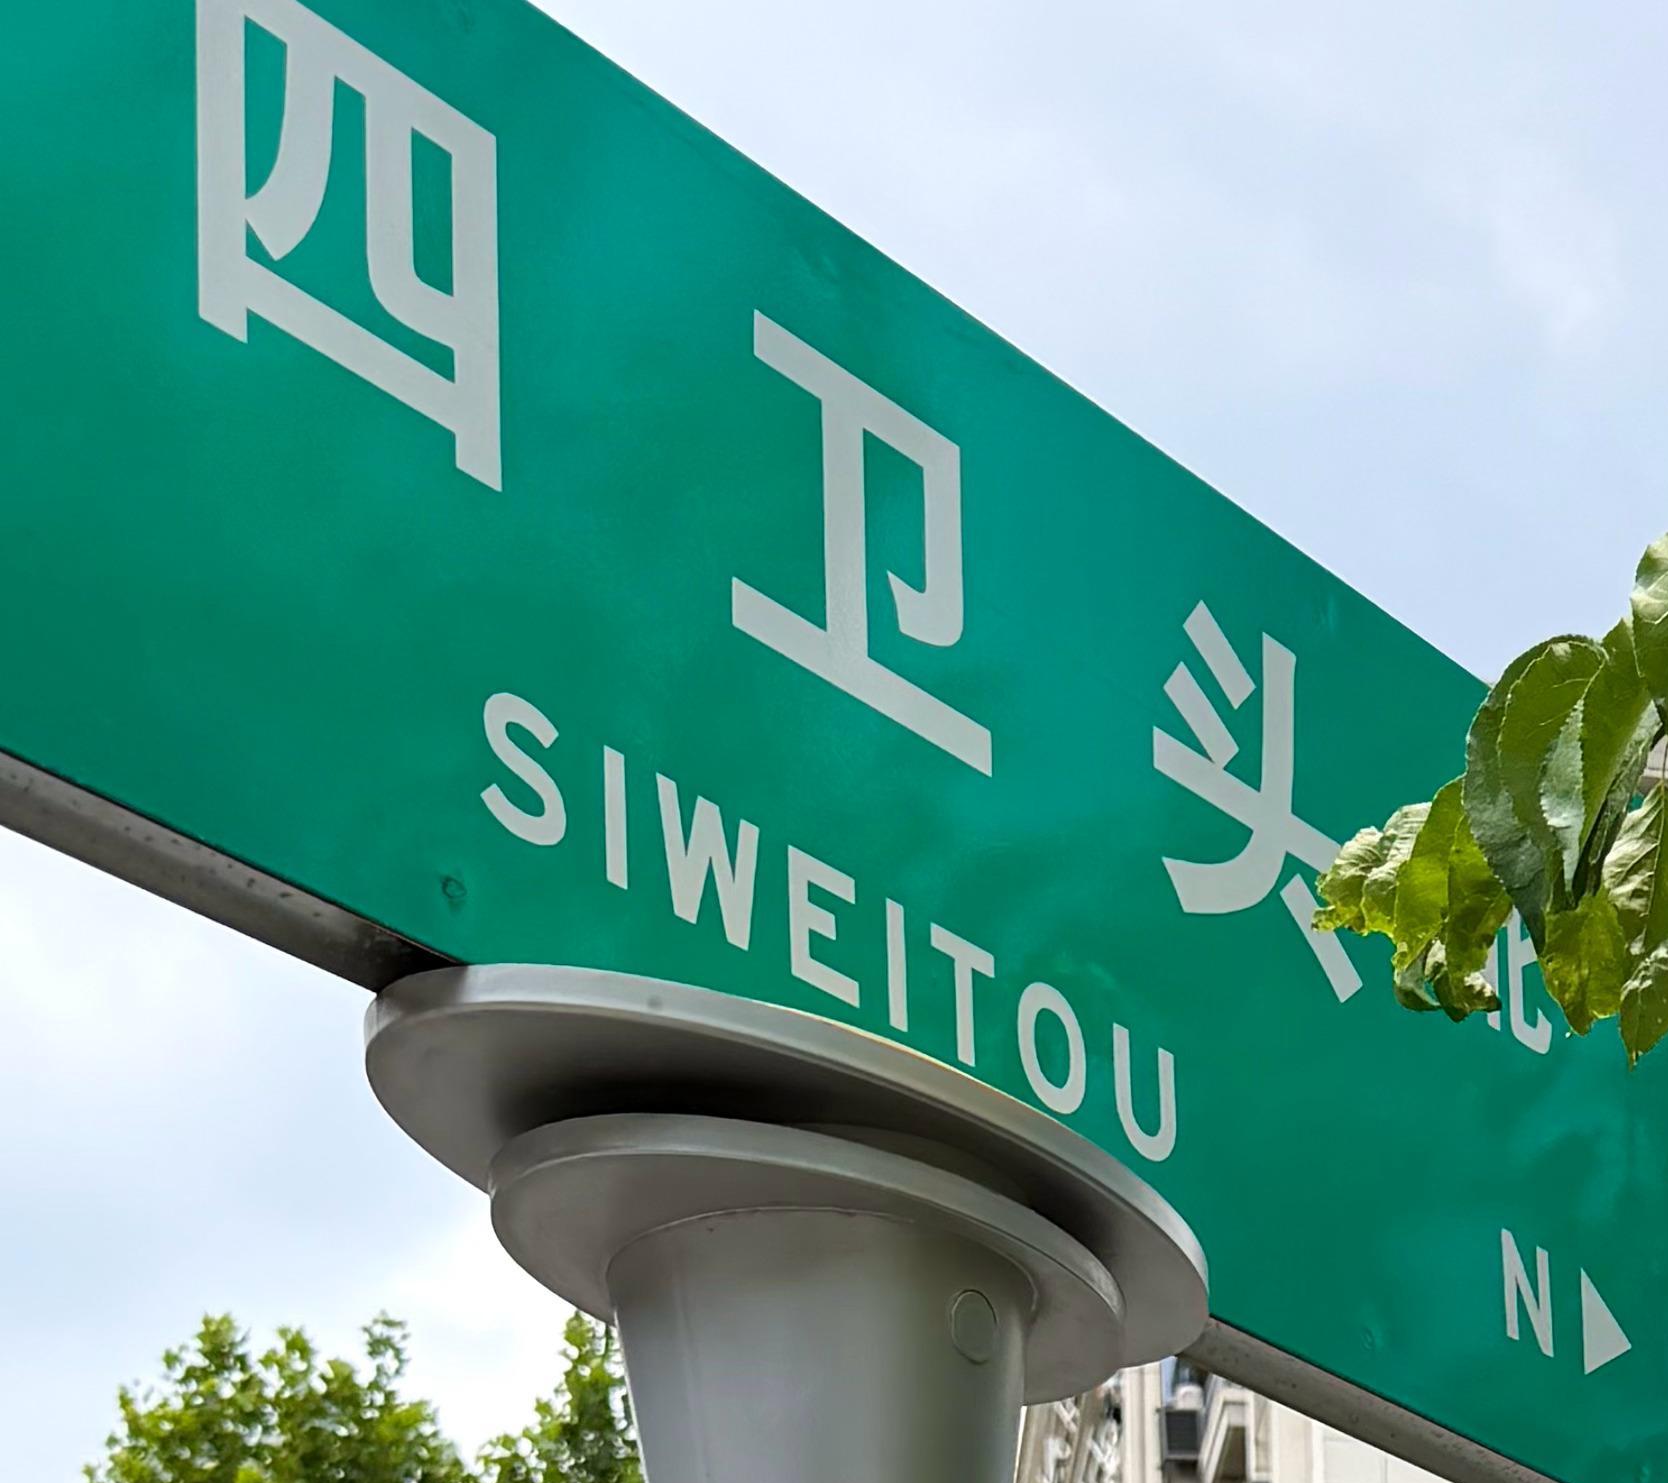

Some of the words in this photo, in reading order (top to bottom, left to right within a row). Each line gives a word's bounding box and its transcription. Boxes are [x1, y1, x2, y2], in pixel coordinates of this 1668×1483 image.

[195, 0, 1363, 1003] 四卫头
[481, 690, 1177, 1163] SIWEITOU
[1501, 1228, 1554, 1357] N
